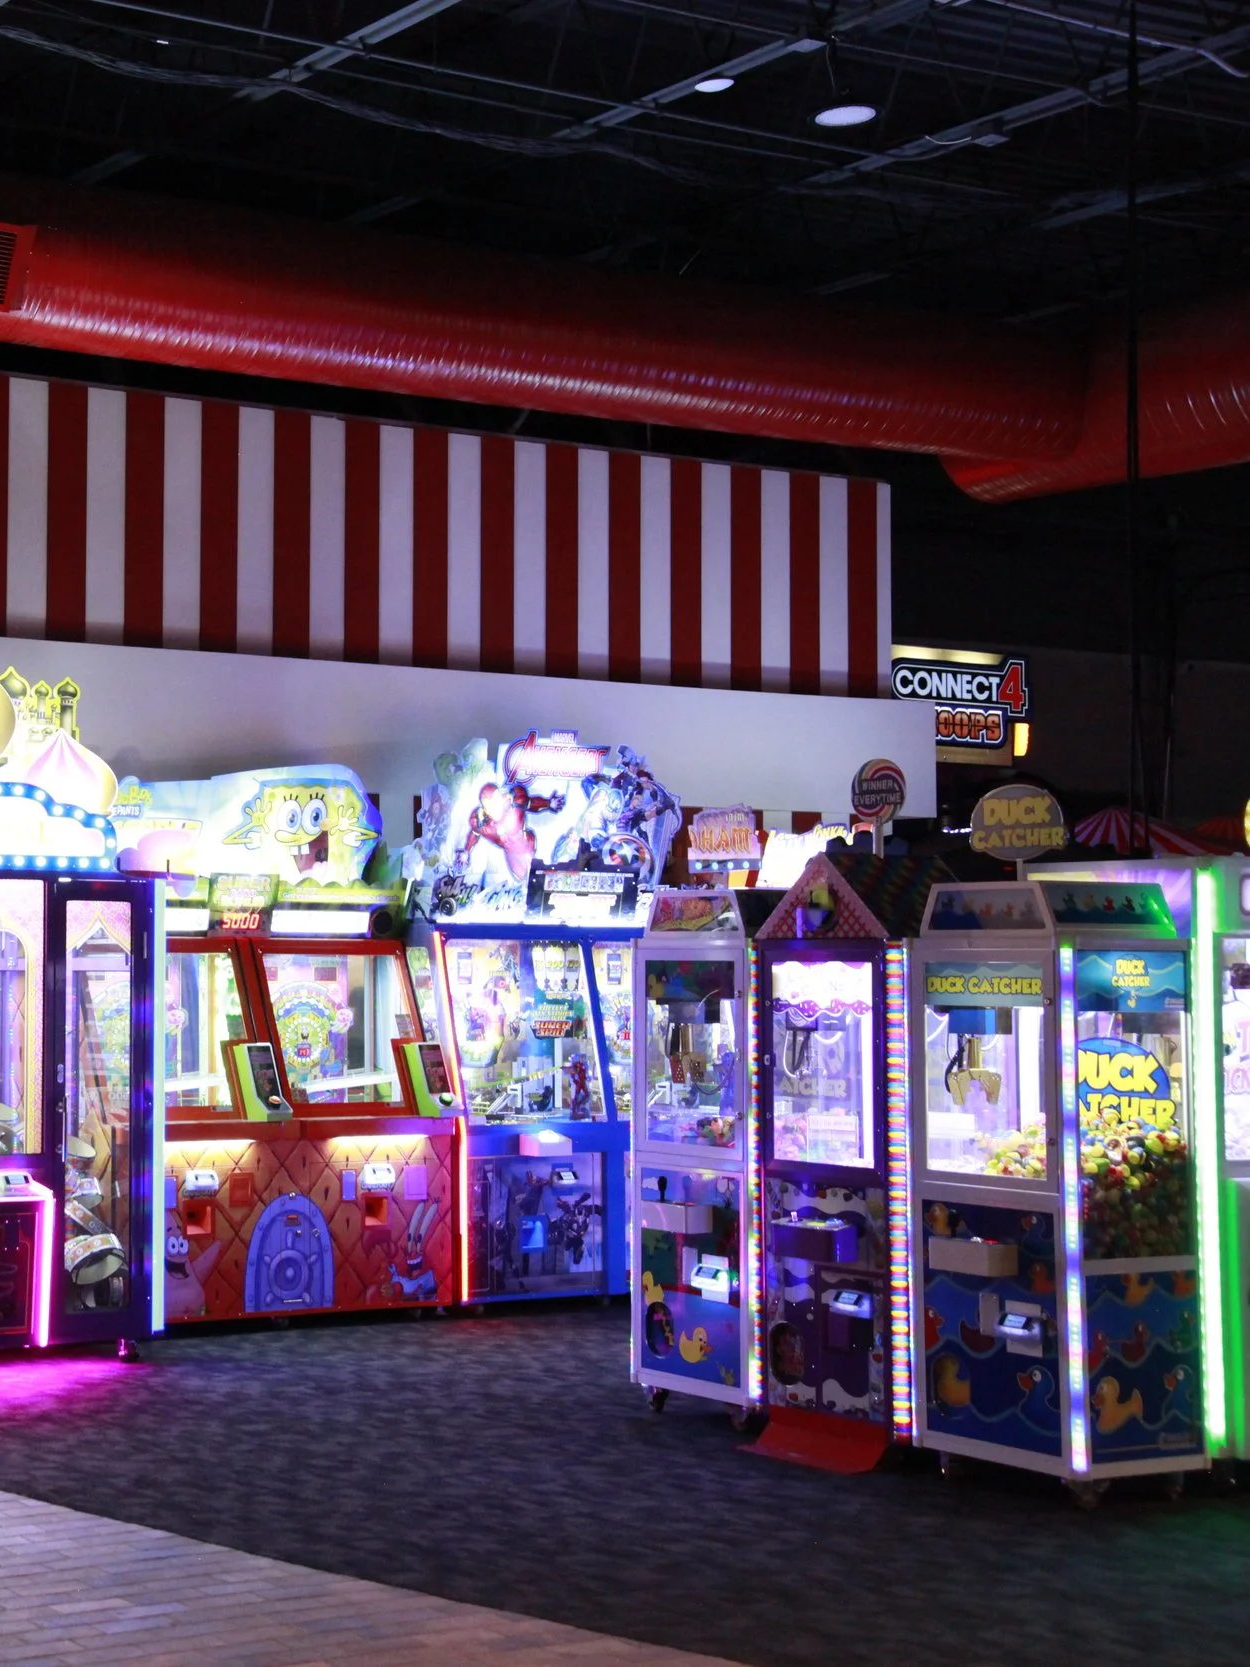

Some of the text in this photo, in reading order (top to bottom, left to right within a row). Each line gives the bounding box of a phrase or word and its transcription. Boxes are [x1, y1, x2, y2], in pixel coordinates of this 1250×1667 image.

[895, 665, 1024, 711] CONNECT 4
[936, 709, 1002, 742] OOPS
[861, 779, 894, 790] WINNER
[983, 796, 1051, 826] DUCK
[973, 826, 1064, 850] CATCHER
[222, 912, 260, 929] 5000
[1115, 959, 1146, 975] DUCK
[927, 975, 1043, 995] DUCK CATCHER
[1111, 975, 1151, 987] CATCHER
[1079, 1093, 1177, 1126] TCHER
